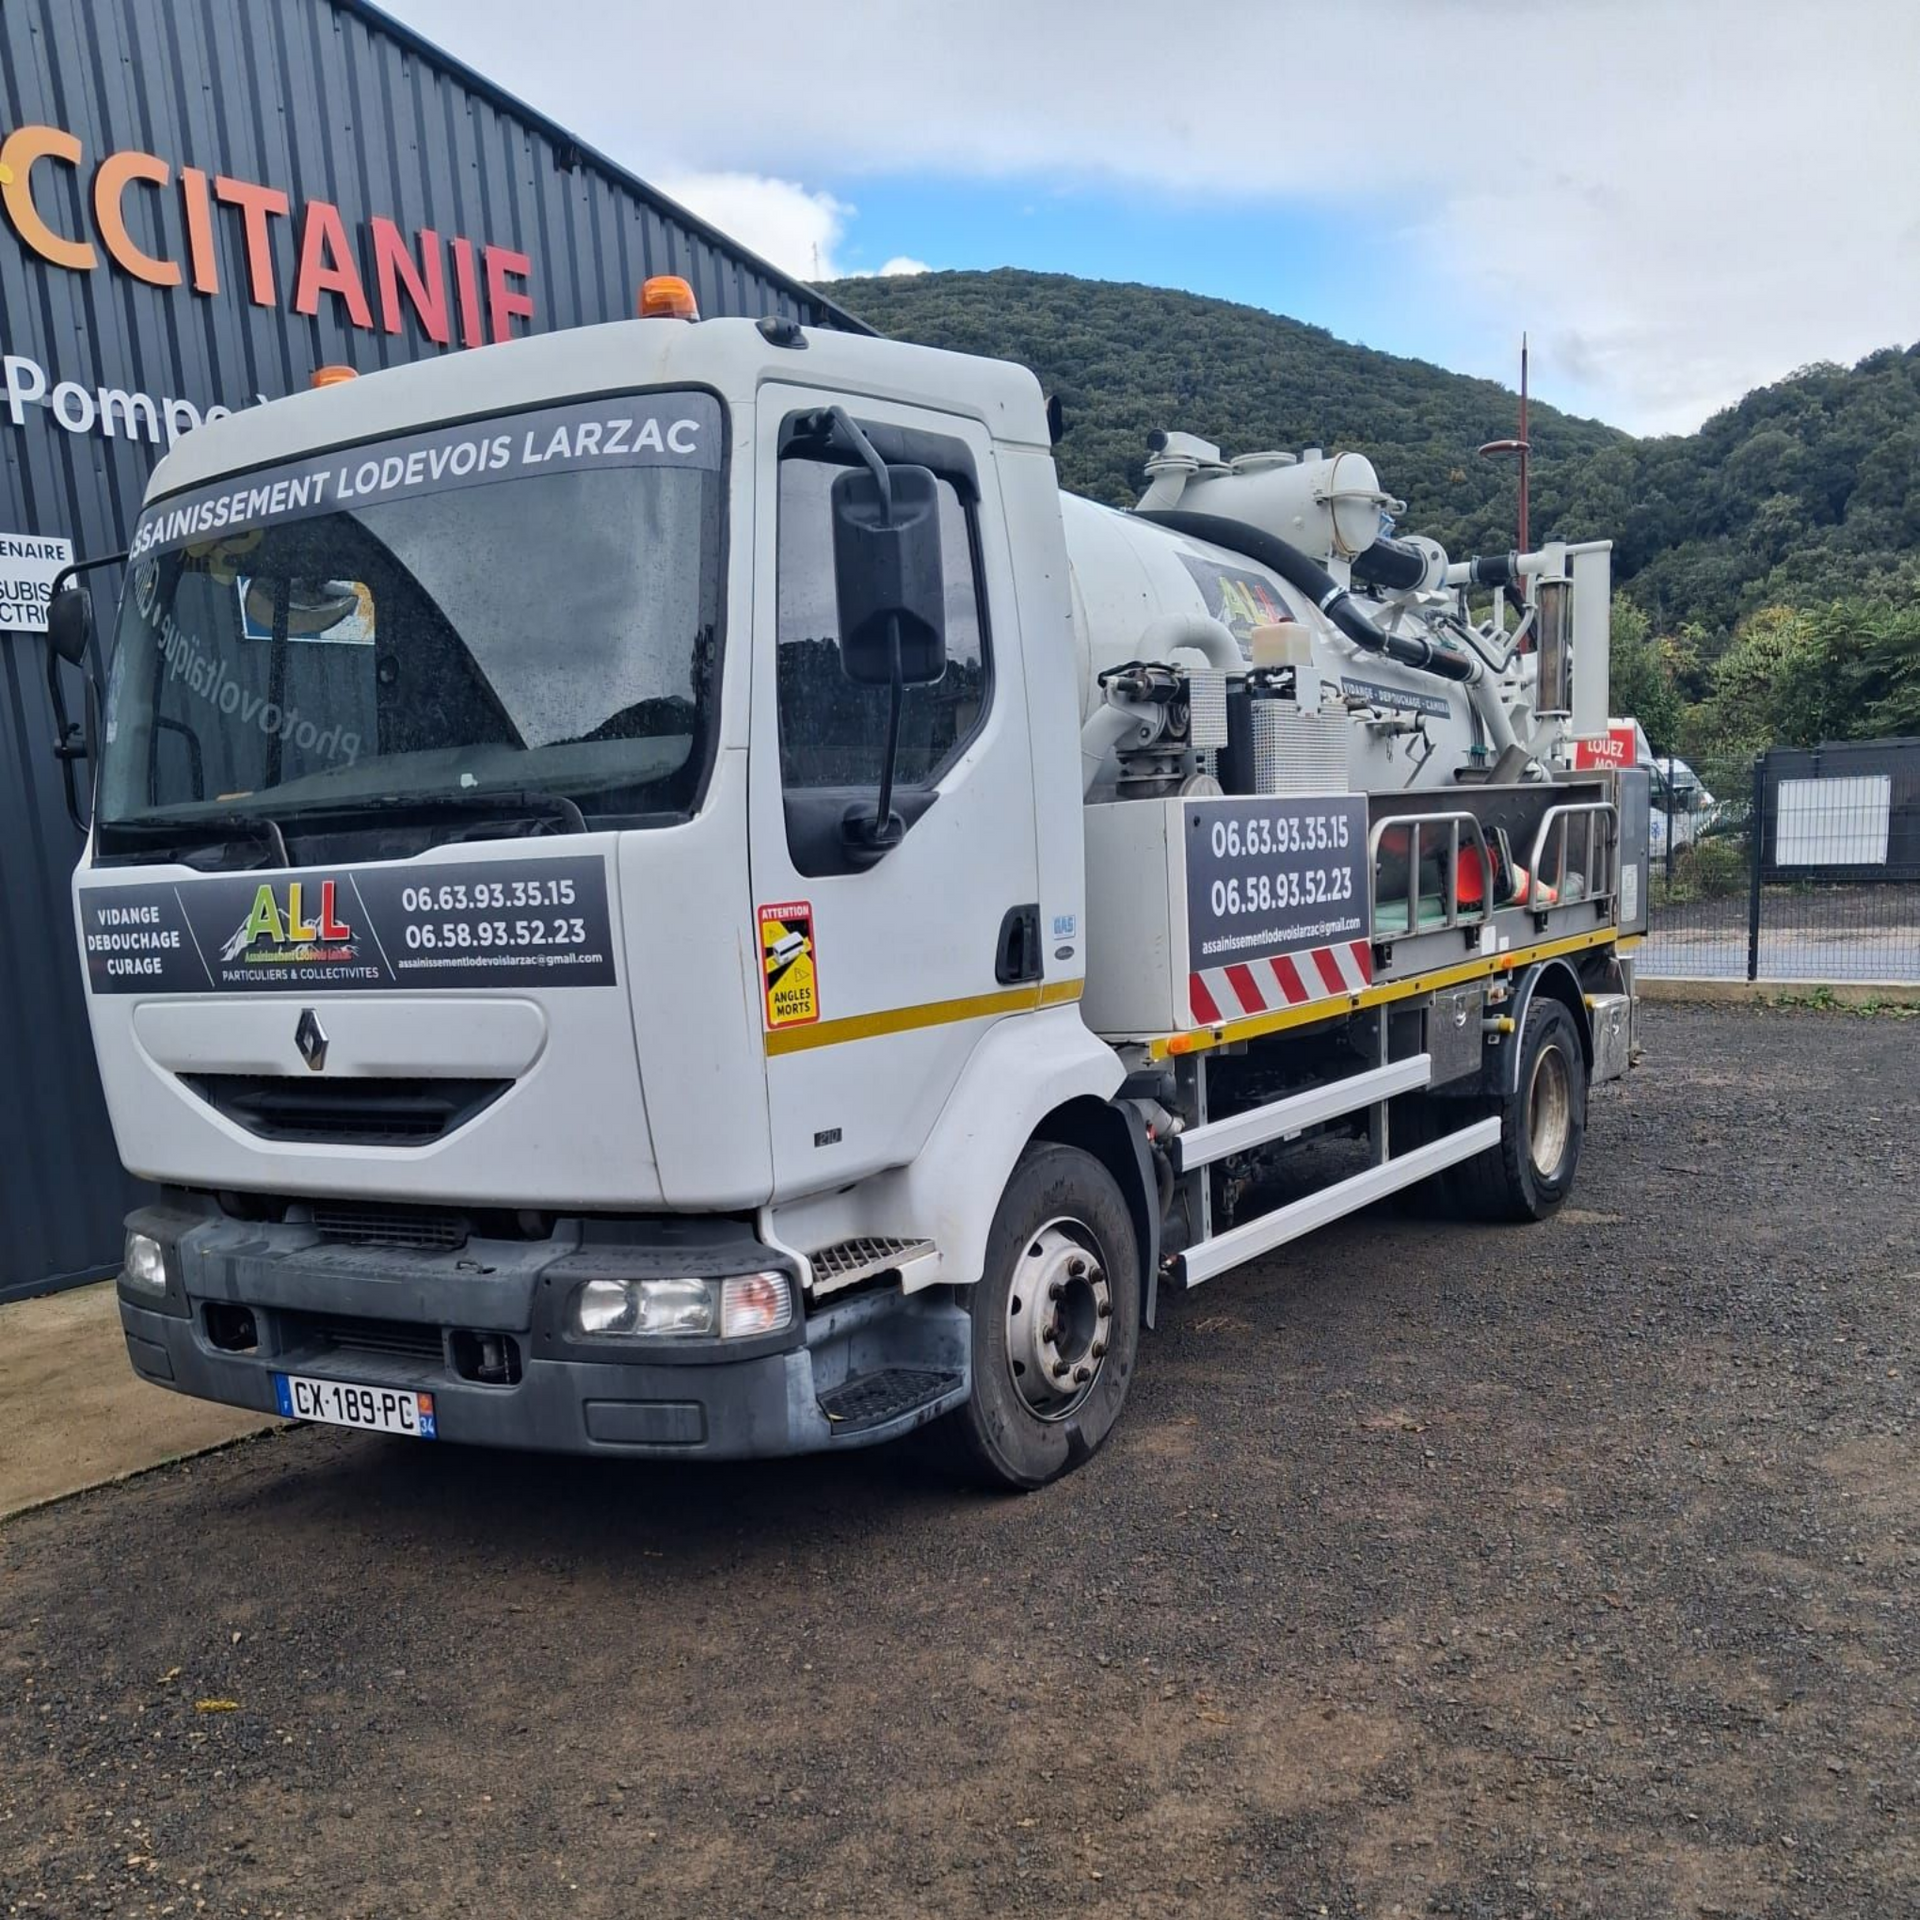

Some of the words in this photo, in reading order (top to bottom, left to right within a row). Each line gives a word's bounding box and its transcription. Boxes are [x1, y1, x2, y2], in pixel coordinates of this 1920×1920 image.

[337, 436, 512, 499] LODEVOIS
[522, 418, 701, 464] LARZAC
[0, 602, 50, 624] CTRI
[1588, 739, 1624, 758] LOUEZ
[1211, 815, 1349, 858] 06.63.93.35.15
[402, 879, 576, 912] 06.63.93.35.15
[1211, 867, 1352, 917] 06.58.93.52.23
[98, 906, 160, 926] VIDANGE
[245, 880, 351, 943] ALL
[762, 905, 810, 920] ATTENTION
[87, 931, 181, 951] DEBOUCHAGE
[405, 918, 586, 949] 06.58.93.52.23
[1202, 916, 1361, 955] assainissementlodevoislarzac@gmail.com
[107, 957, 163, 975] CURAGE
[398, 952, 603, 969] assainissementlodevoislarzac@gmail.com
[222, 969, 288, 981] PARTICULIERS
[290, 969, 298, 980] &
[300, 967, 379, 979] COLLECTIVITES
[774, 987, 811, 1004] ANGLES
[776, 1001, 811, 1017] MORTS
[295, 1381, 414, 1429] CX-189-PC
[420, 1416, 434, 1434] 34
